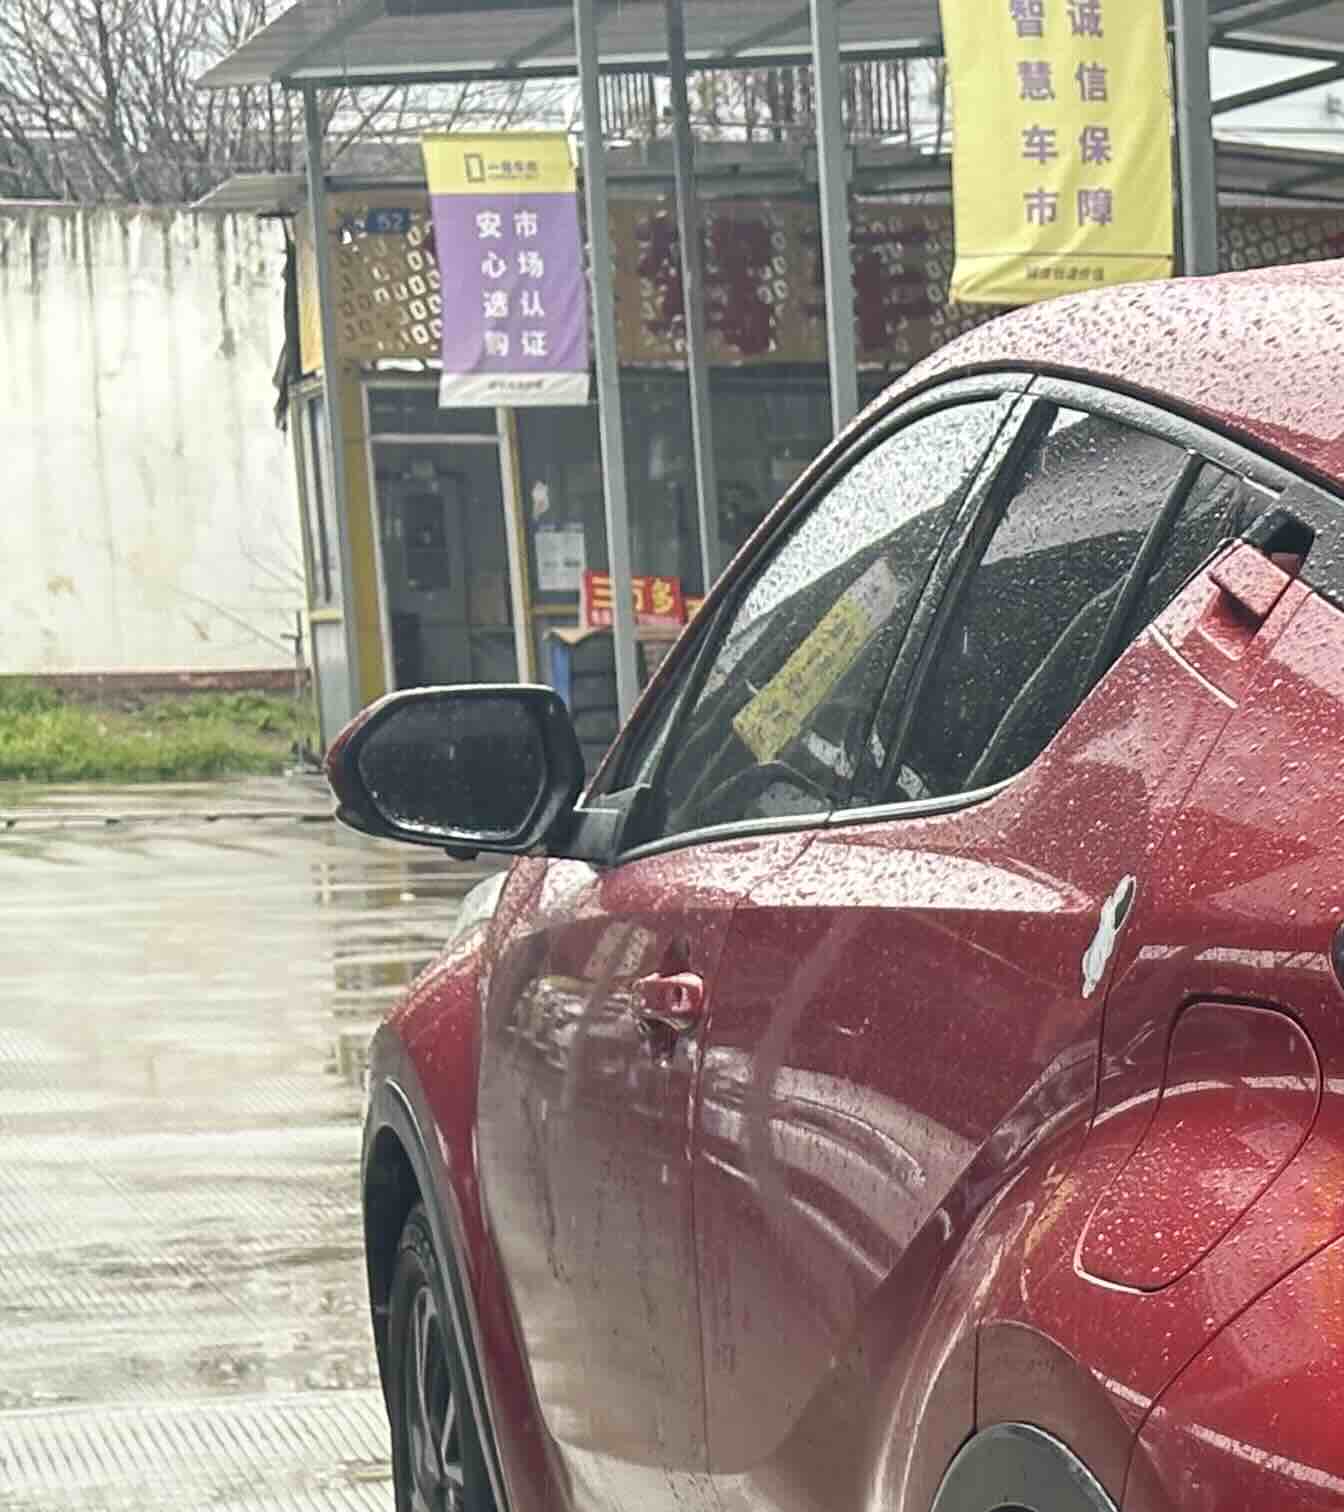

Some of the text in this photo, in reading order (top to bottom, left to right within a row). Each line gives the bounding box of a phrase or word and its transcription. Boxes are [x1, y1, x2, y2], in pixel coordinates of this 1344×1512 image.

[1067, 0, 1114, 227] 诚信保障
[476, 210, 509, 357] 安心选购
[513, 210, 548, 357] 市场认证
